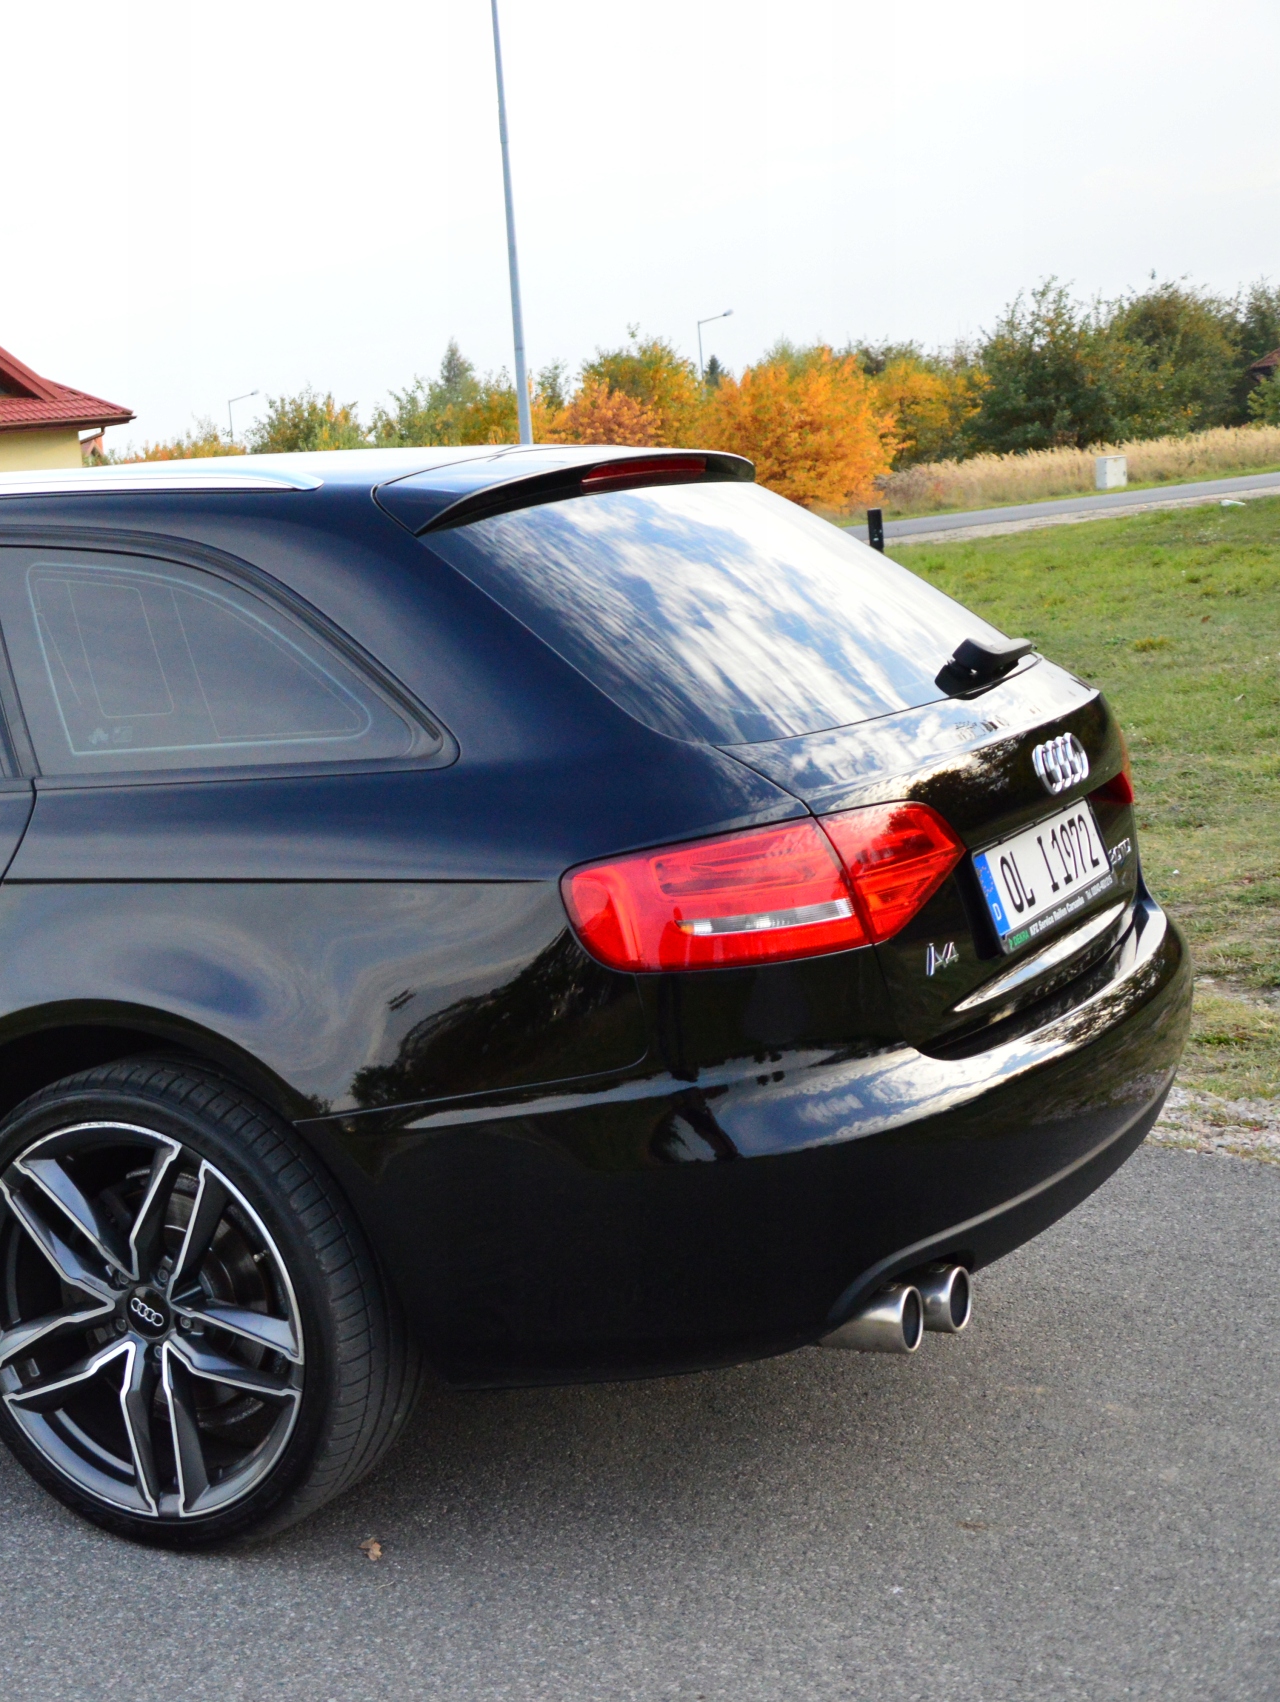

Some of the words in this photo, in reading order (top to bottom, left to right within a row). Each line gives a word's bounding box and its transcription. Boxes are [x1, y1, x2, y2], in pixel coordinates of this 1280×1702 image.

[999, 850, 1035, 914] OL
[992, 902, 1003, 921] D
[1038, 915, 1055, 931] Service
